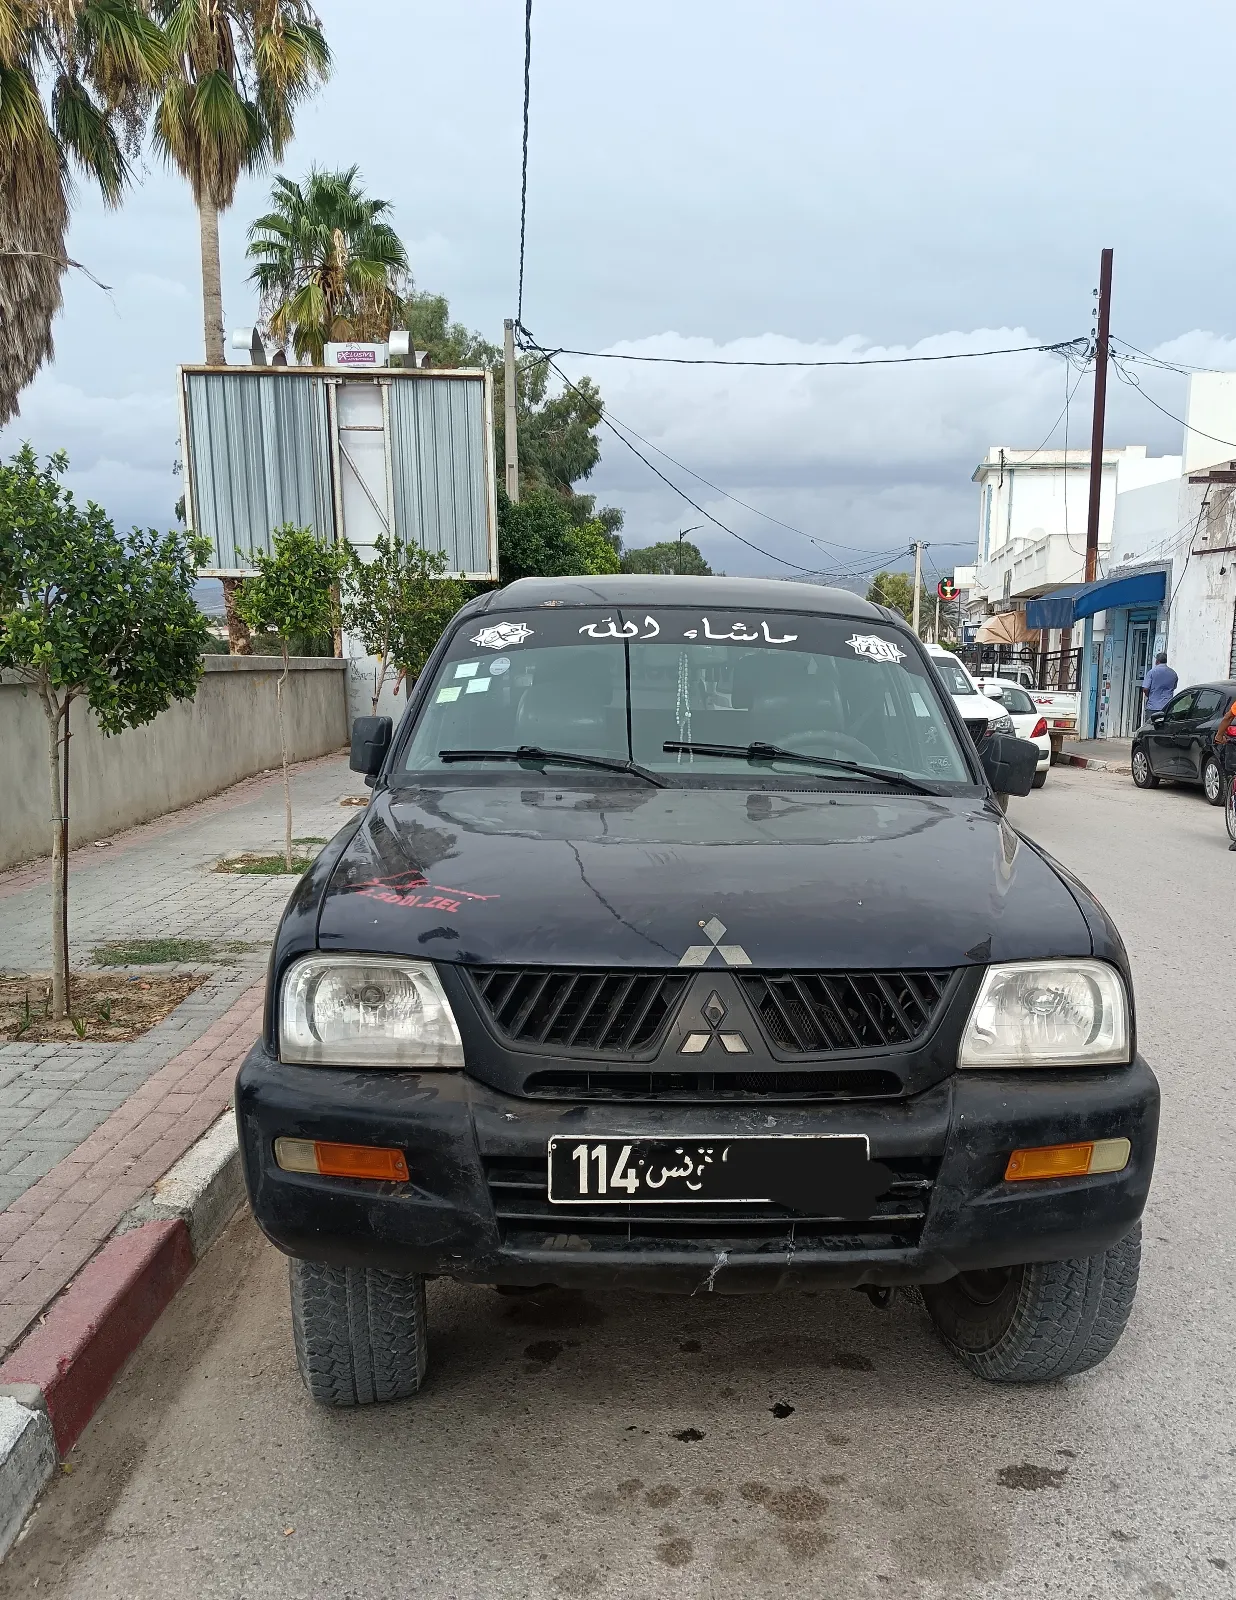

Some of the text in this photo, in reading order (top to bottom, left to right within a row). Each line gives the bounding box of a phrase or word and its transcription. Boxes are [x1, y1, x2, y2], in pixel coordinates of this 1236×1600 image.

[337, 351, 374, 361] EXCLUSIVE
[578, 615, 798, 648] ماشاء الله
[572, 1143, 640, 1194] 114
